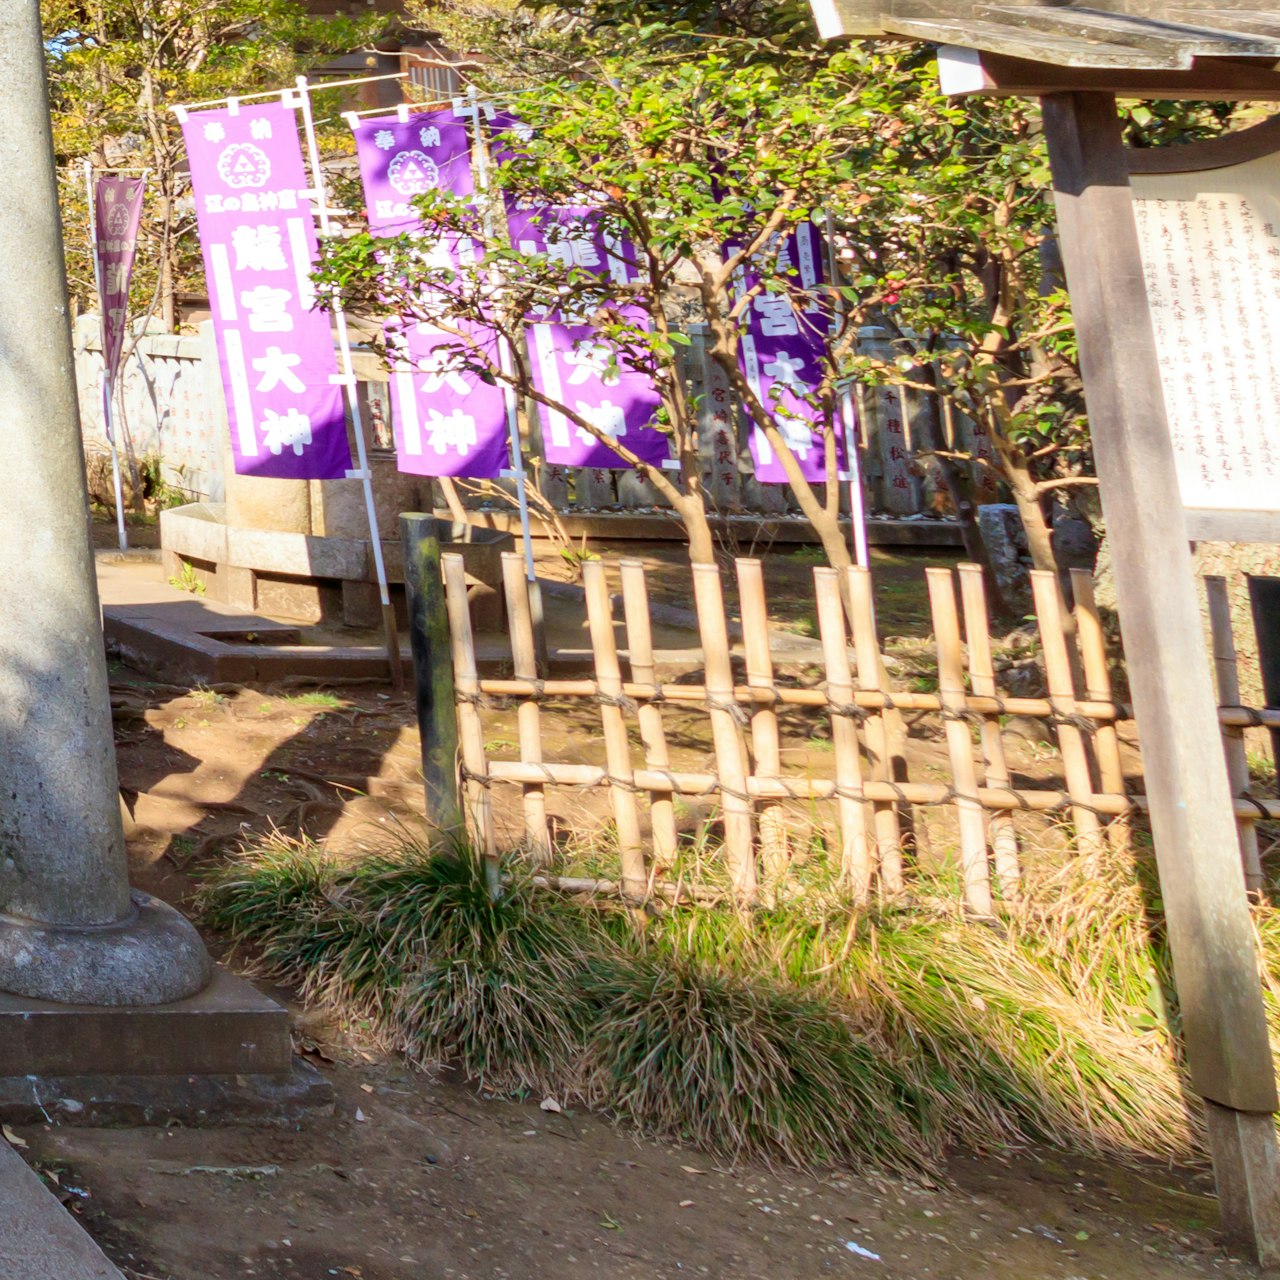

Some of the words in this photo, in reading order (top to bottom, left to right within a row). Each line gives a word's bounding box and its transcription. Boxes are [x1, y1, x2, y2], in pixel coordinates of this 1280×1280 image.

[374, 126, 440, 151] 奉納
[231, 224, 313, 456] 龍宮大神
